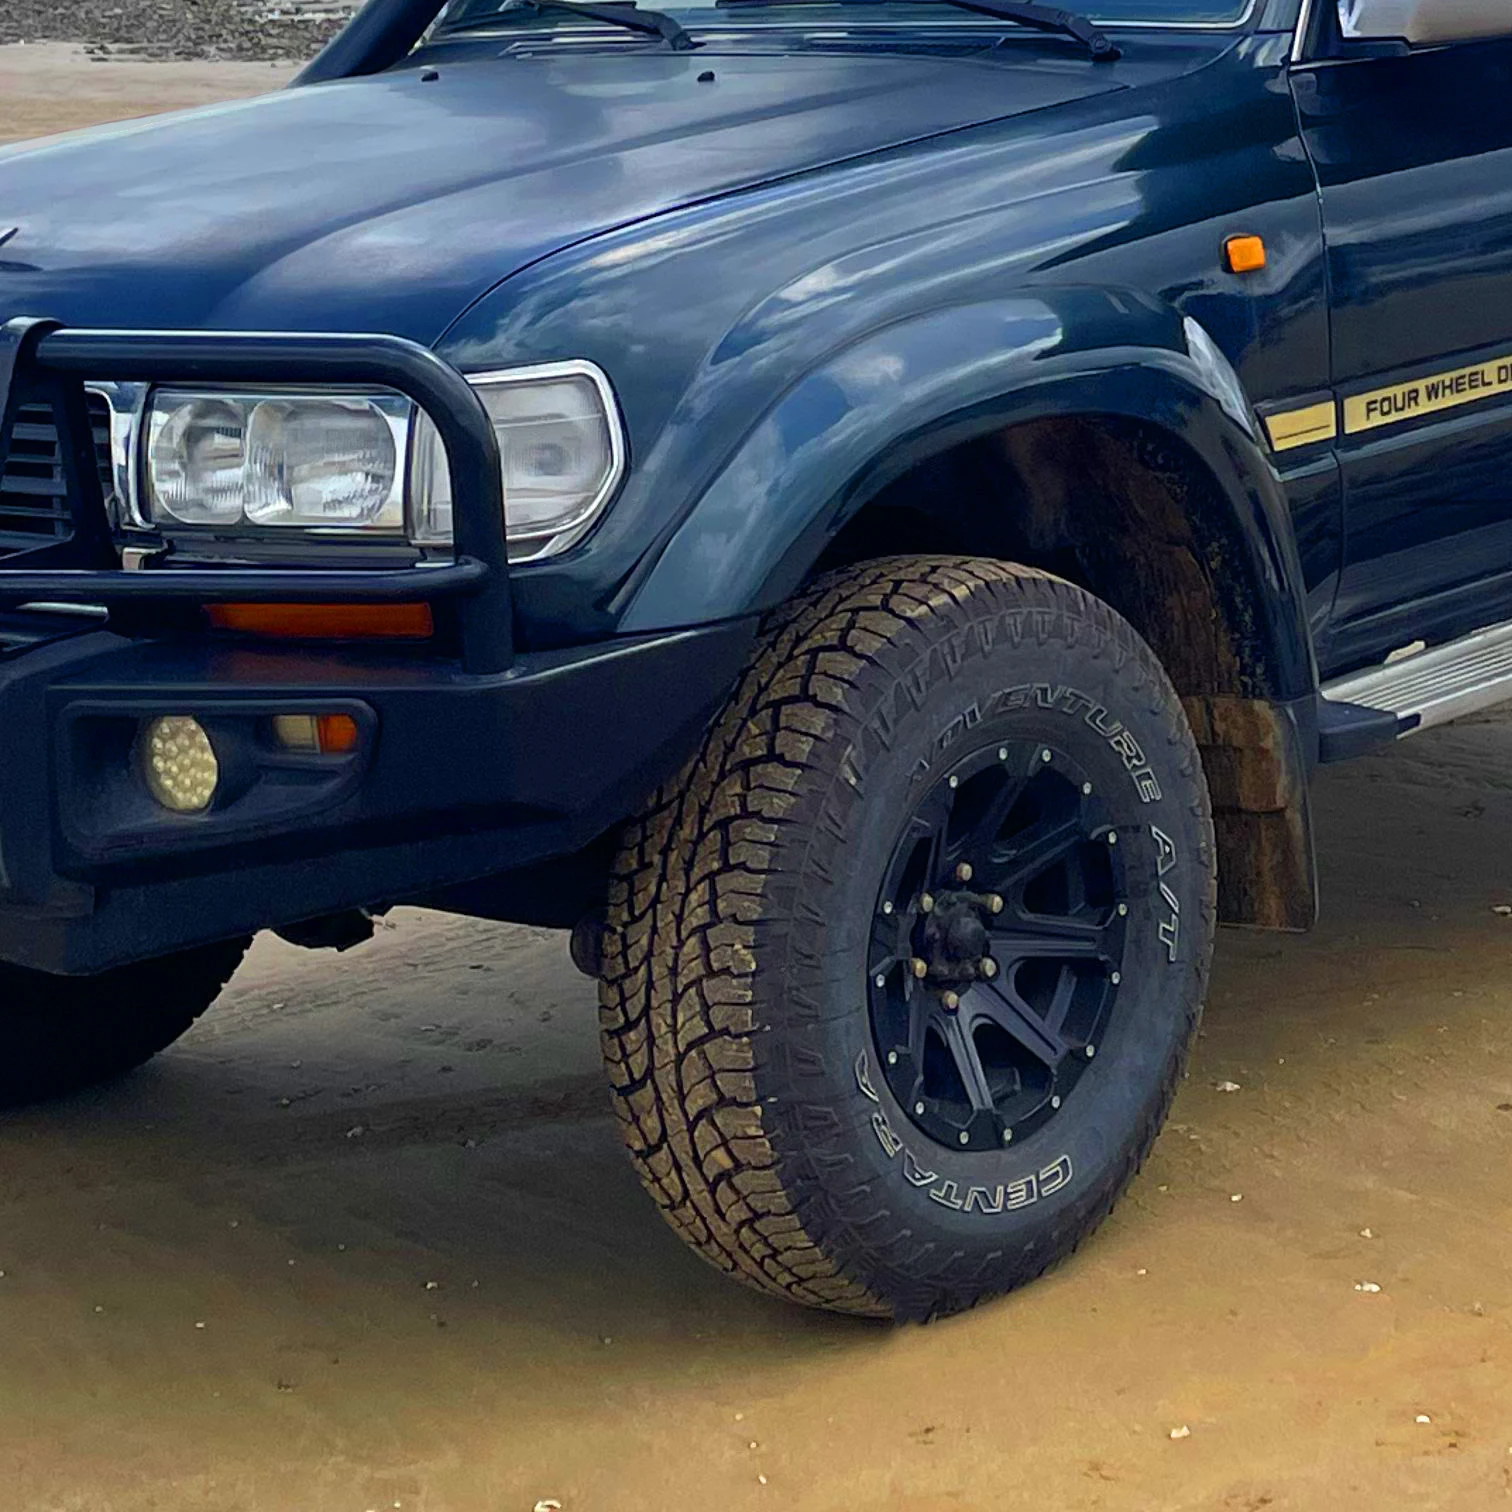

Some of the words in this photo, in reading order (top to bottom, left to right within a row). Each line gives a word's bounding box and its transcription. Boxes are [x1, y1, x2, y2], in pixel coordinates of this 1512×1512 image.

[1366, 388, 1420, 421] FOUR
[1425, 369, 1493, 402] WHEEL
[1150, 824, 1180, 963] A/T
[855, 1048, 1073, 1214] CENTARA
